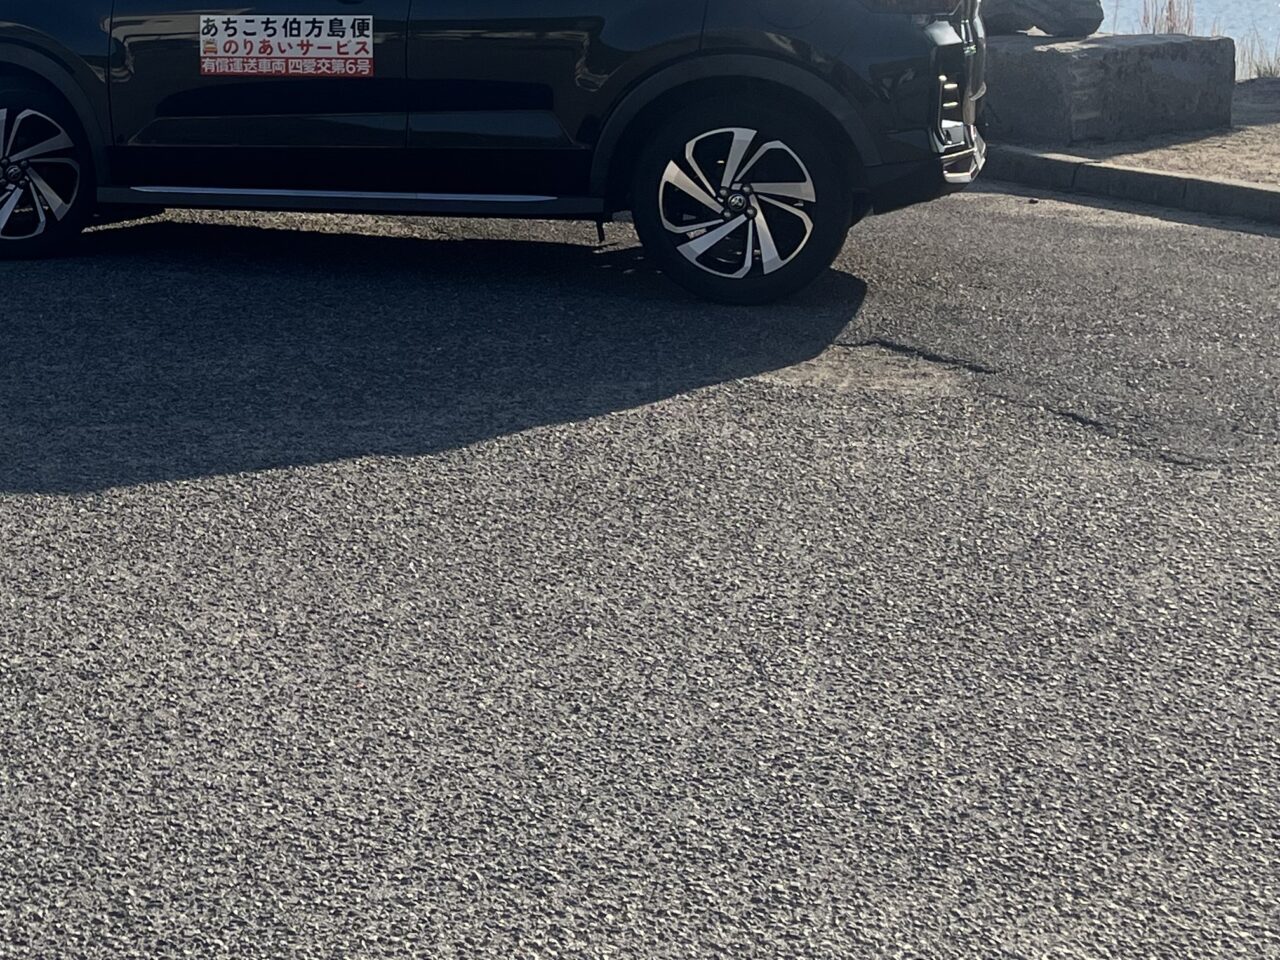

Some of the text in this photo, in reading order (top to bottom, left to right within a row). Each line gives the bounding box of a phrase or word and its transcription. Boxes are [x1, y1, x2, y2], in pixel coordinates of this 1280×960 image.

[201, 17, 371, 38] あちこち伯方島便
[223, 39, 370, 55] のりあいサービス
[201, 57, 286, 74] 有償運送車両
